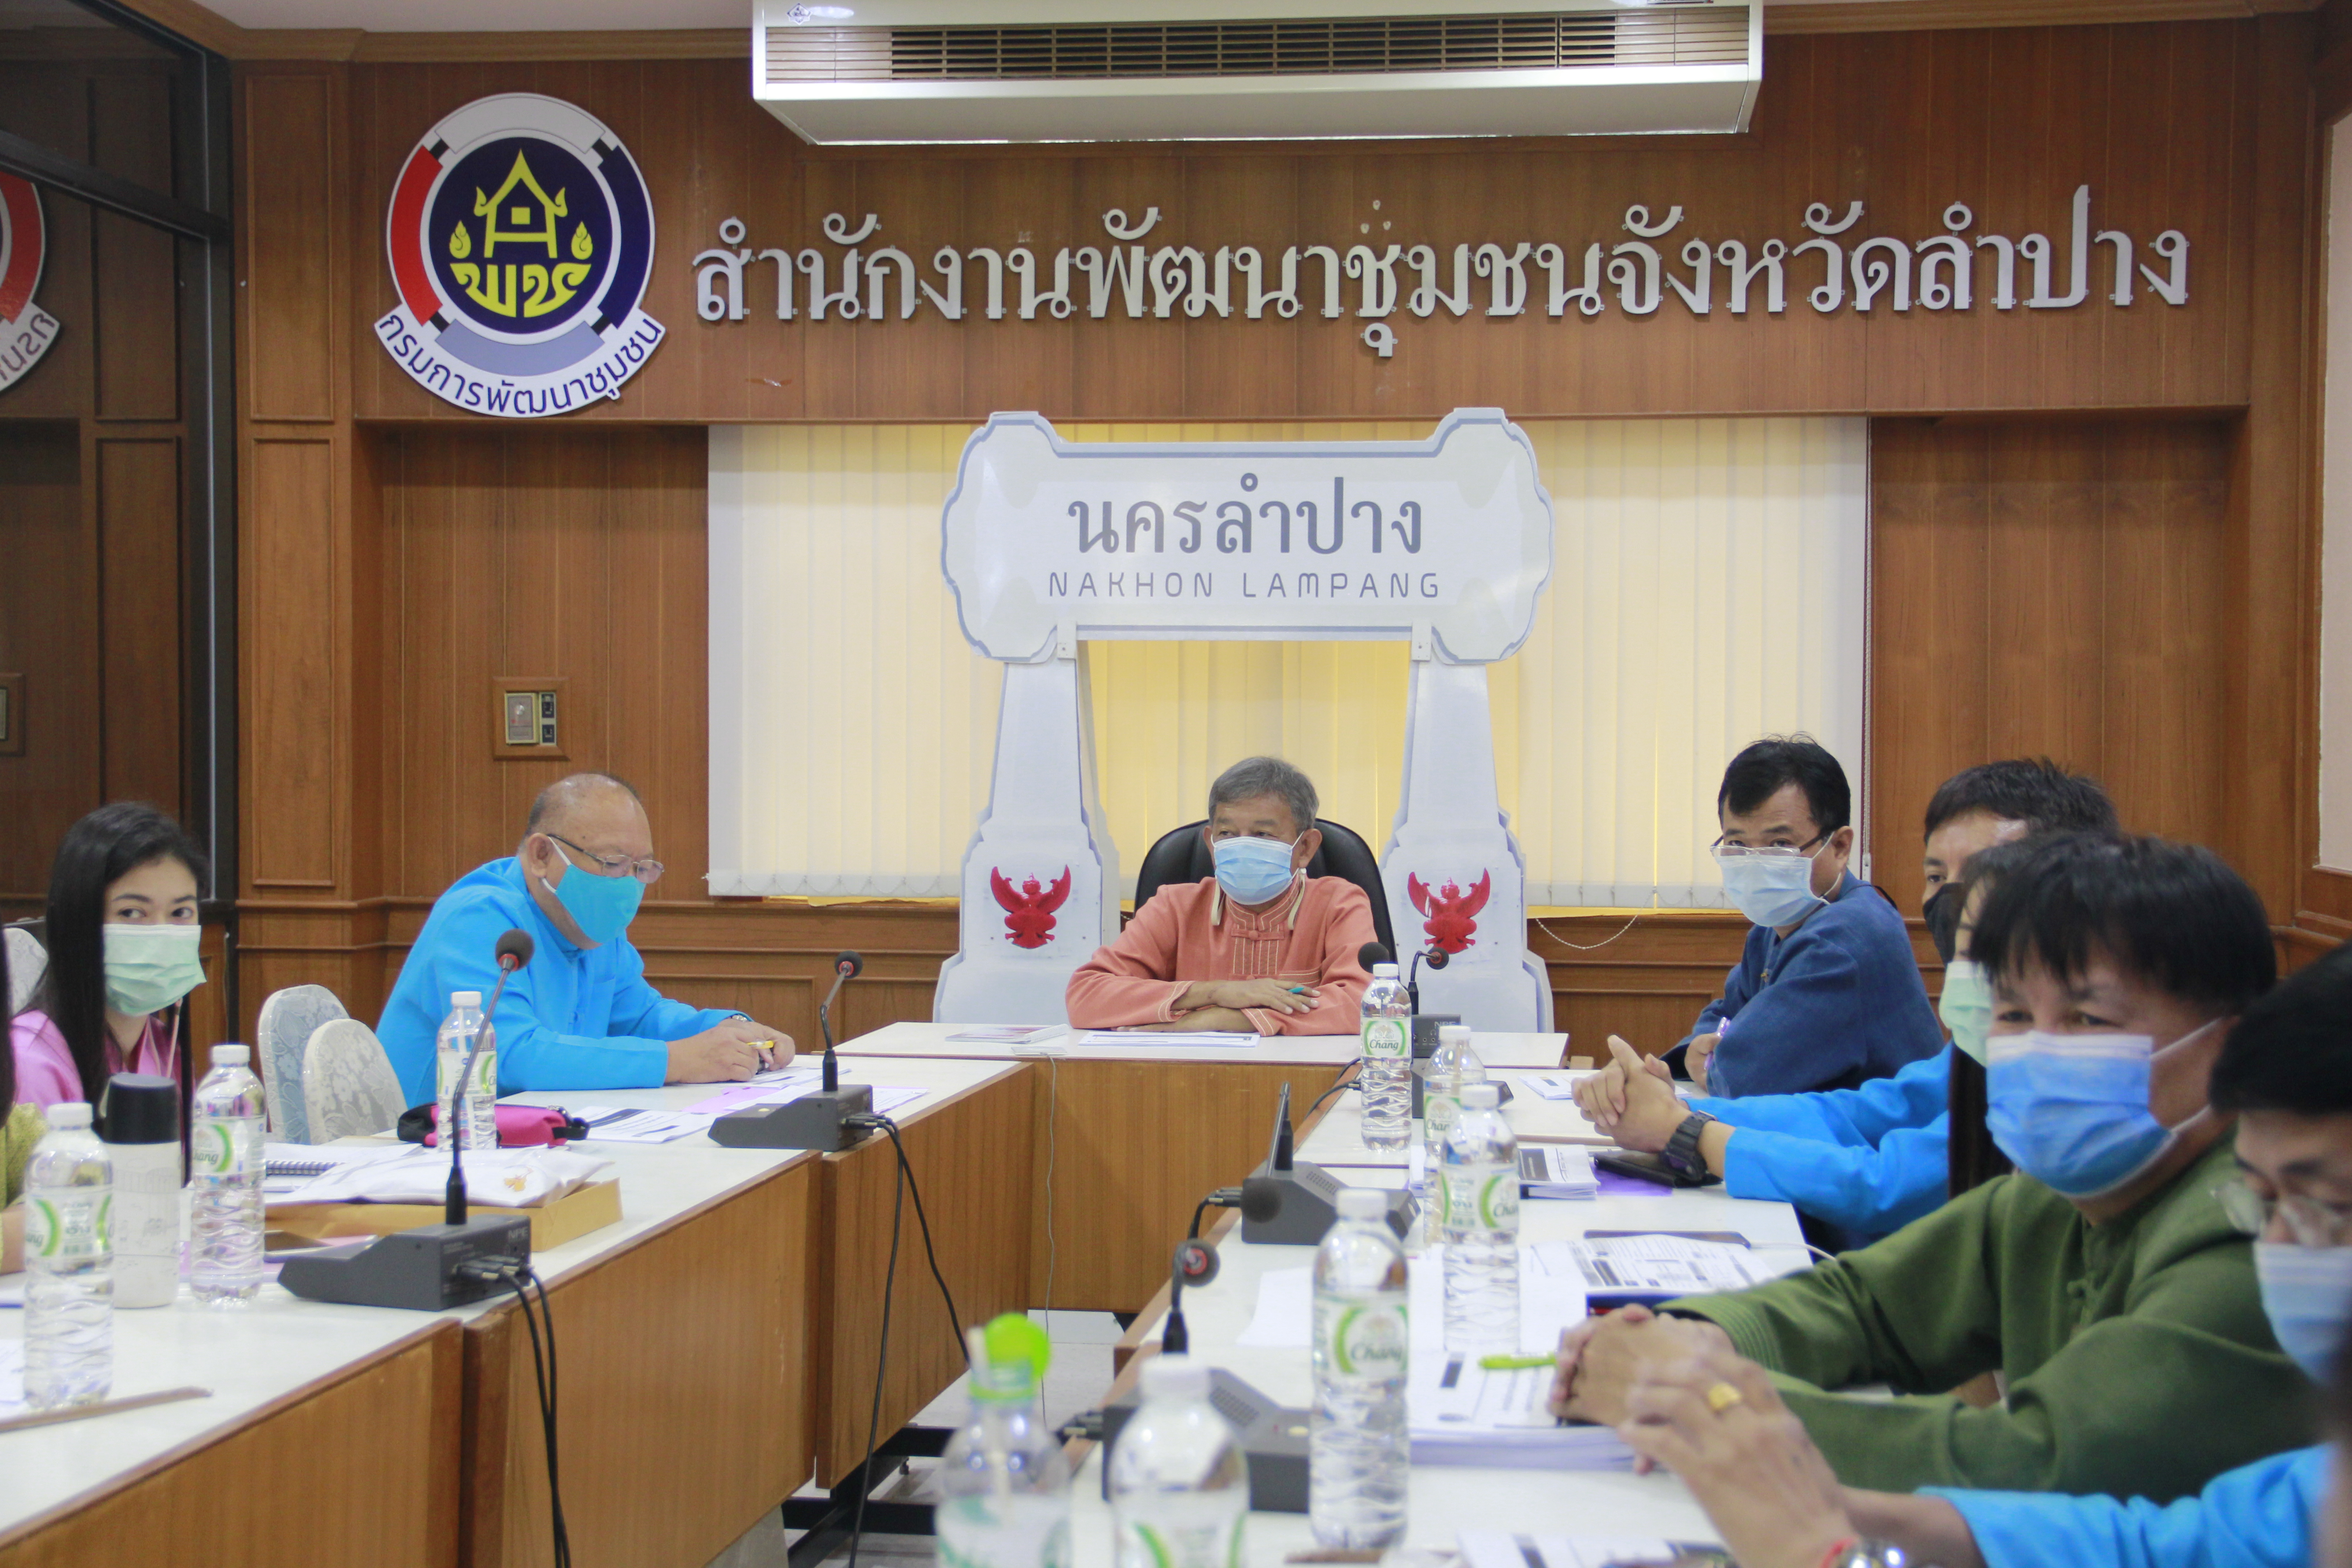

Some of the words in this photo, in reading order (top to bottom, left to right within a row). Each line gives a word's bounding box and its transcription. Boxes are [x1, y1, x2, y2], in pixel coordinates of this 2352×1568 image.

[693, 184, 2190, 357] สำนักงานพัฒนาชุมชนจังหวัดลำปาง
[379, 314, 662, 415] กรมการพัฒนาชุมชน
[1068, 473, 1422, 554] นครลำปาง
[1049, 571, 1214, 598] NAKHON
[1242, 572, 1440, 599] LAMPANG
[1369, 1039, 1399, 1051] Chang
